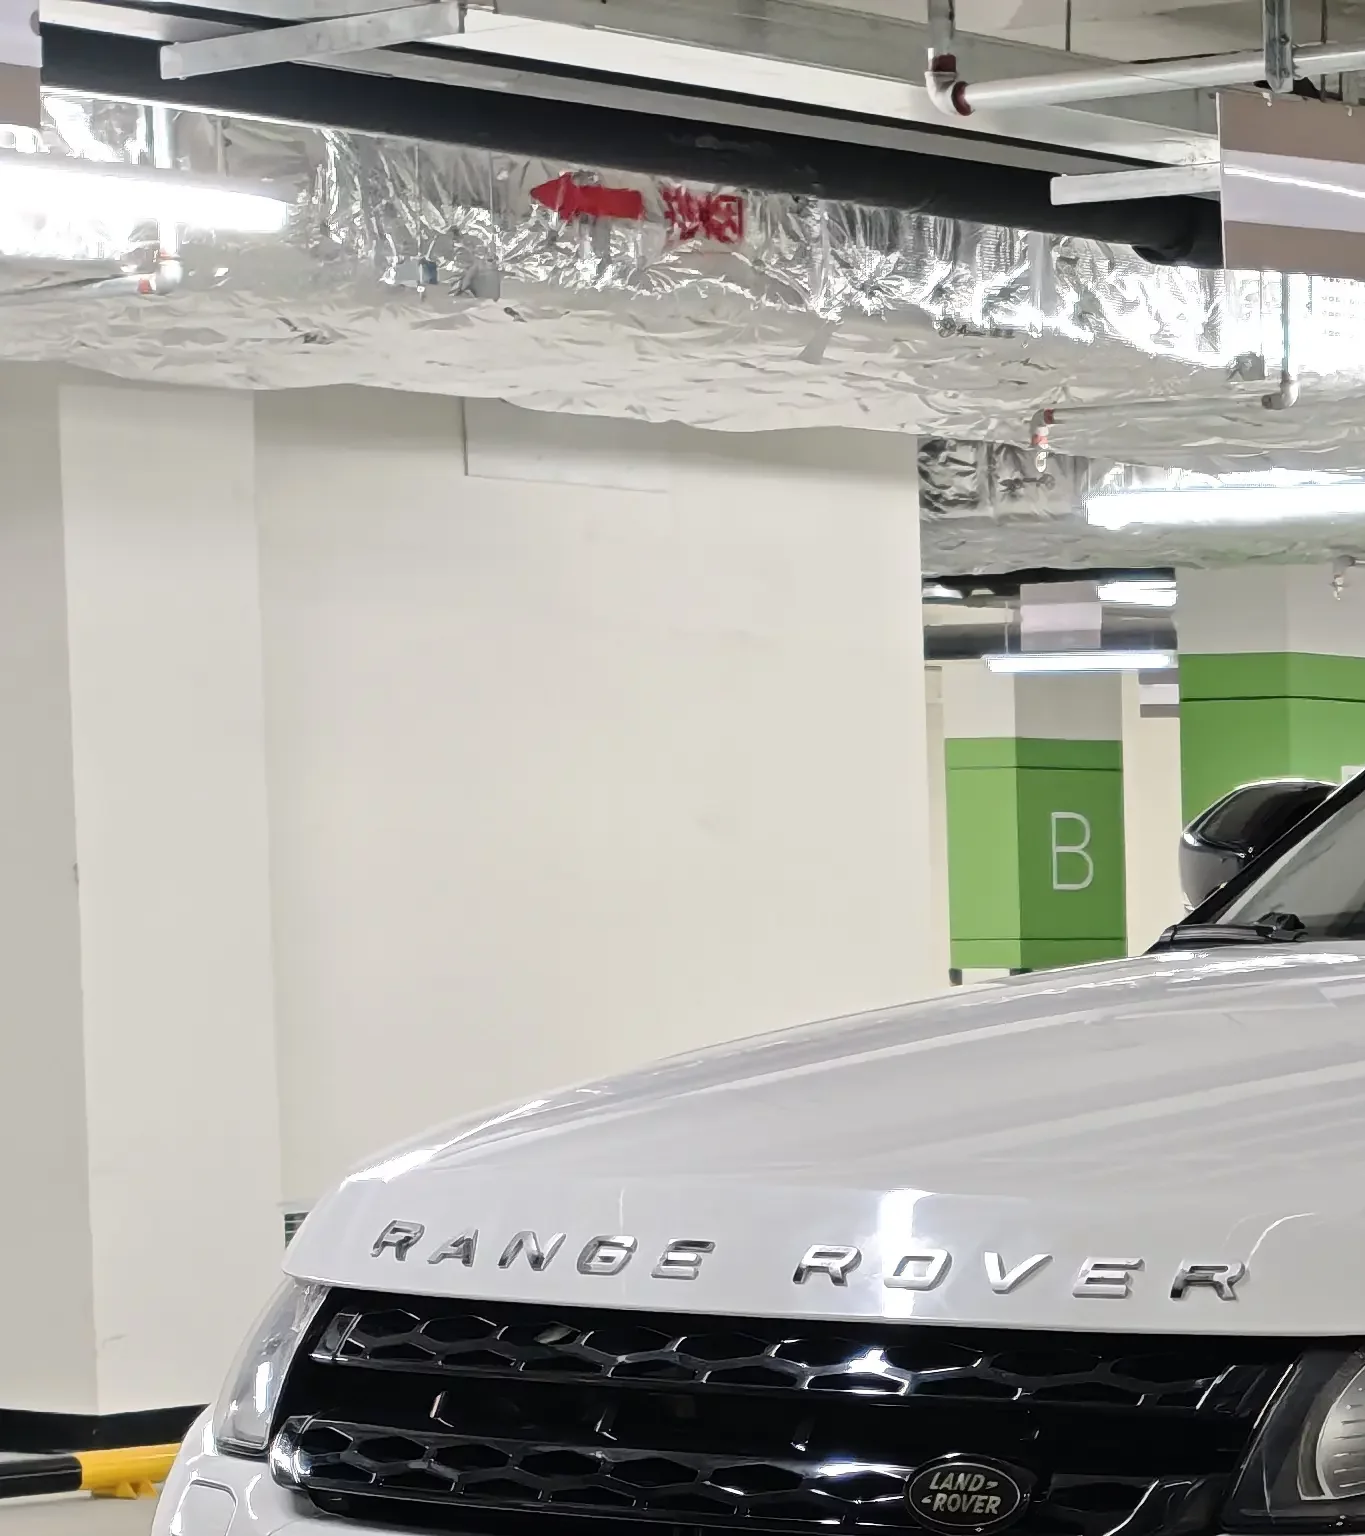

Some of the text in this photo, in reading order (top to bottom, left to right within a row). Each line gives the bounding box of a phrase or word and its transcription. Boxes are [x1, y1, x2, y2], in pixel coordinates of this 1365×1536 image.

[1051, 811, 1094, 890] B
[370, 1219, 1249, 1301] RANGE ROVER
[929, 1471, 986, 1492] LAND
[932, 1492, 1002, 1515] ROVER
